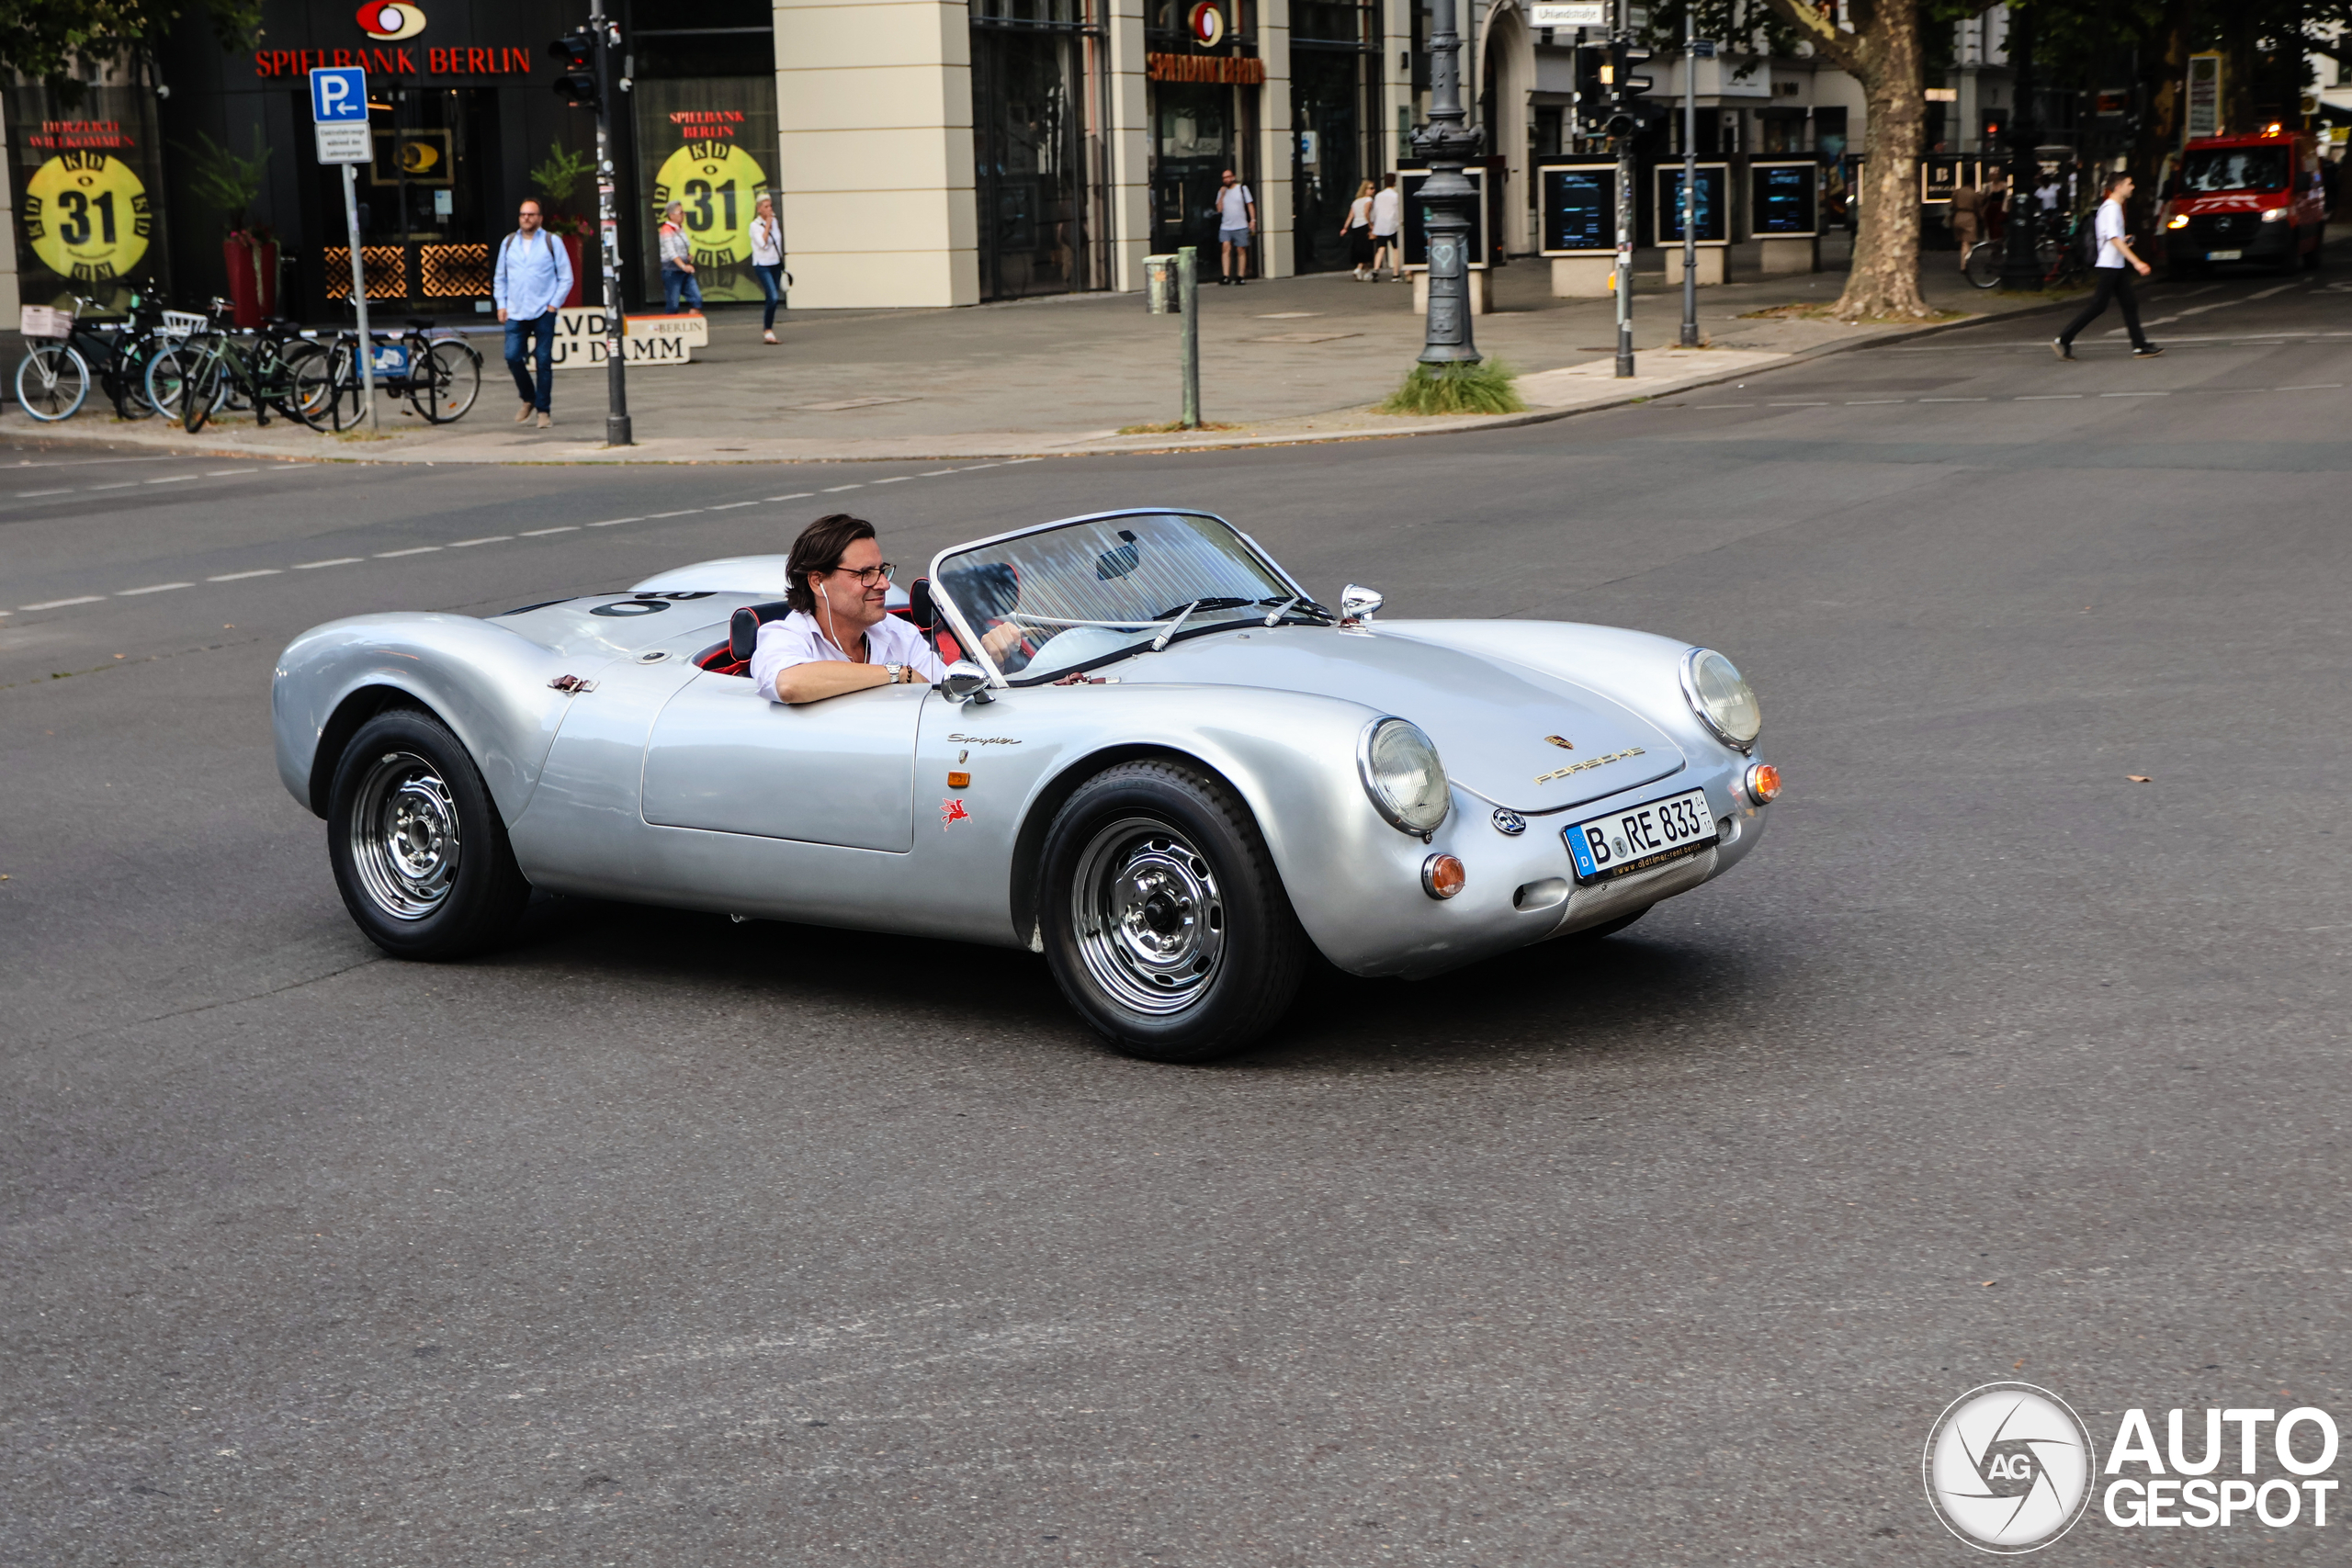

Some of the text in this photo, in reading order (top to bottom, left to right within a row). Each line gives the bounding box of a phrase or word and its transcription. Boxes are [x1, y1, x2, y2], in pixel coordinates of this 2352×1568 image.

[255, 47, 531, 77] SPIELBANK BERLIN
[320, 75, 350, 117] P
[670, 110, 745, 124] SPIELBANK
[683, 126, 734, 138] BERLIN
[58, 190, 117, 245] 31
[684, 179, 738, 231] 31
[659, 321, 703, 334] BERLIN
[947, 734, 1022, 746] Spyder
[1533, 747, 1645, 785] PORSCHE
[1586, 798, 1701, 865] B RE 833
[1580, 855, 1589, 868] D
